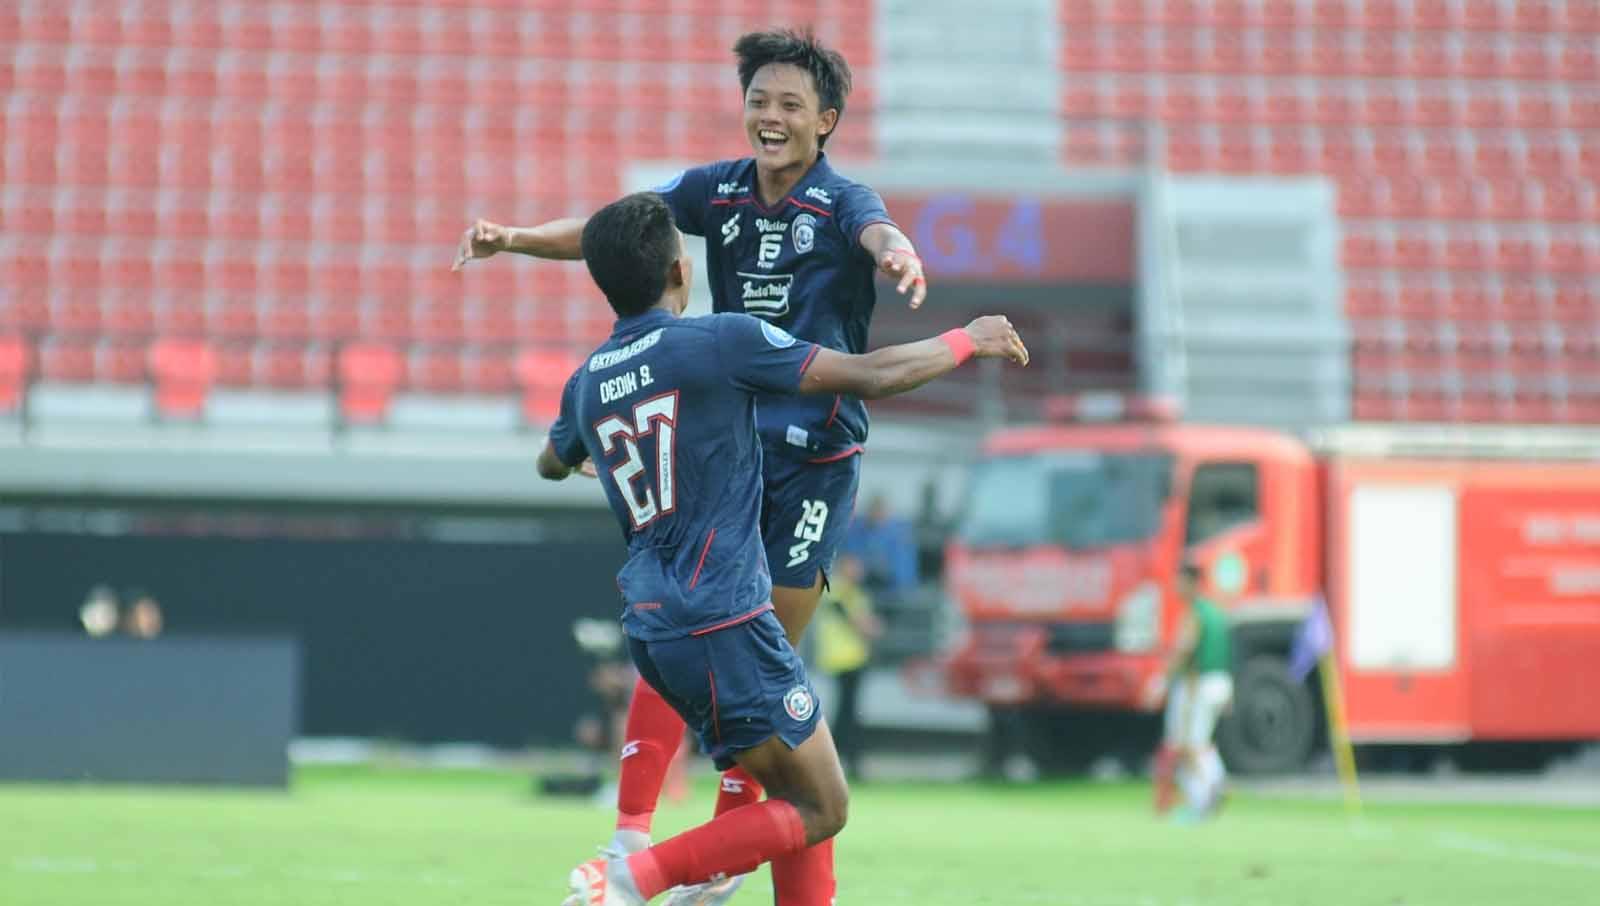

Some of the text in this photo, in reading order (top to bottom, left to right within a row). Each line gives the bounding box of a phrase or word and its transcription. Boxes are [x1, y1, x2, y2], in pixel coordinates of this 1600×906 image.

[600, 371, 638, 404] DEDIK
[592, 389, 680, 531] 27
[793, 499, 829, 543] 19
